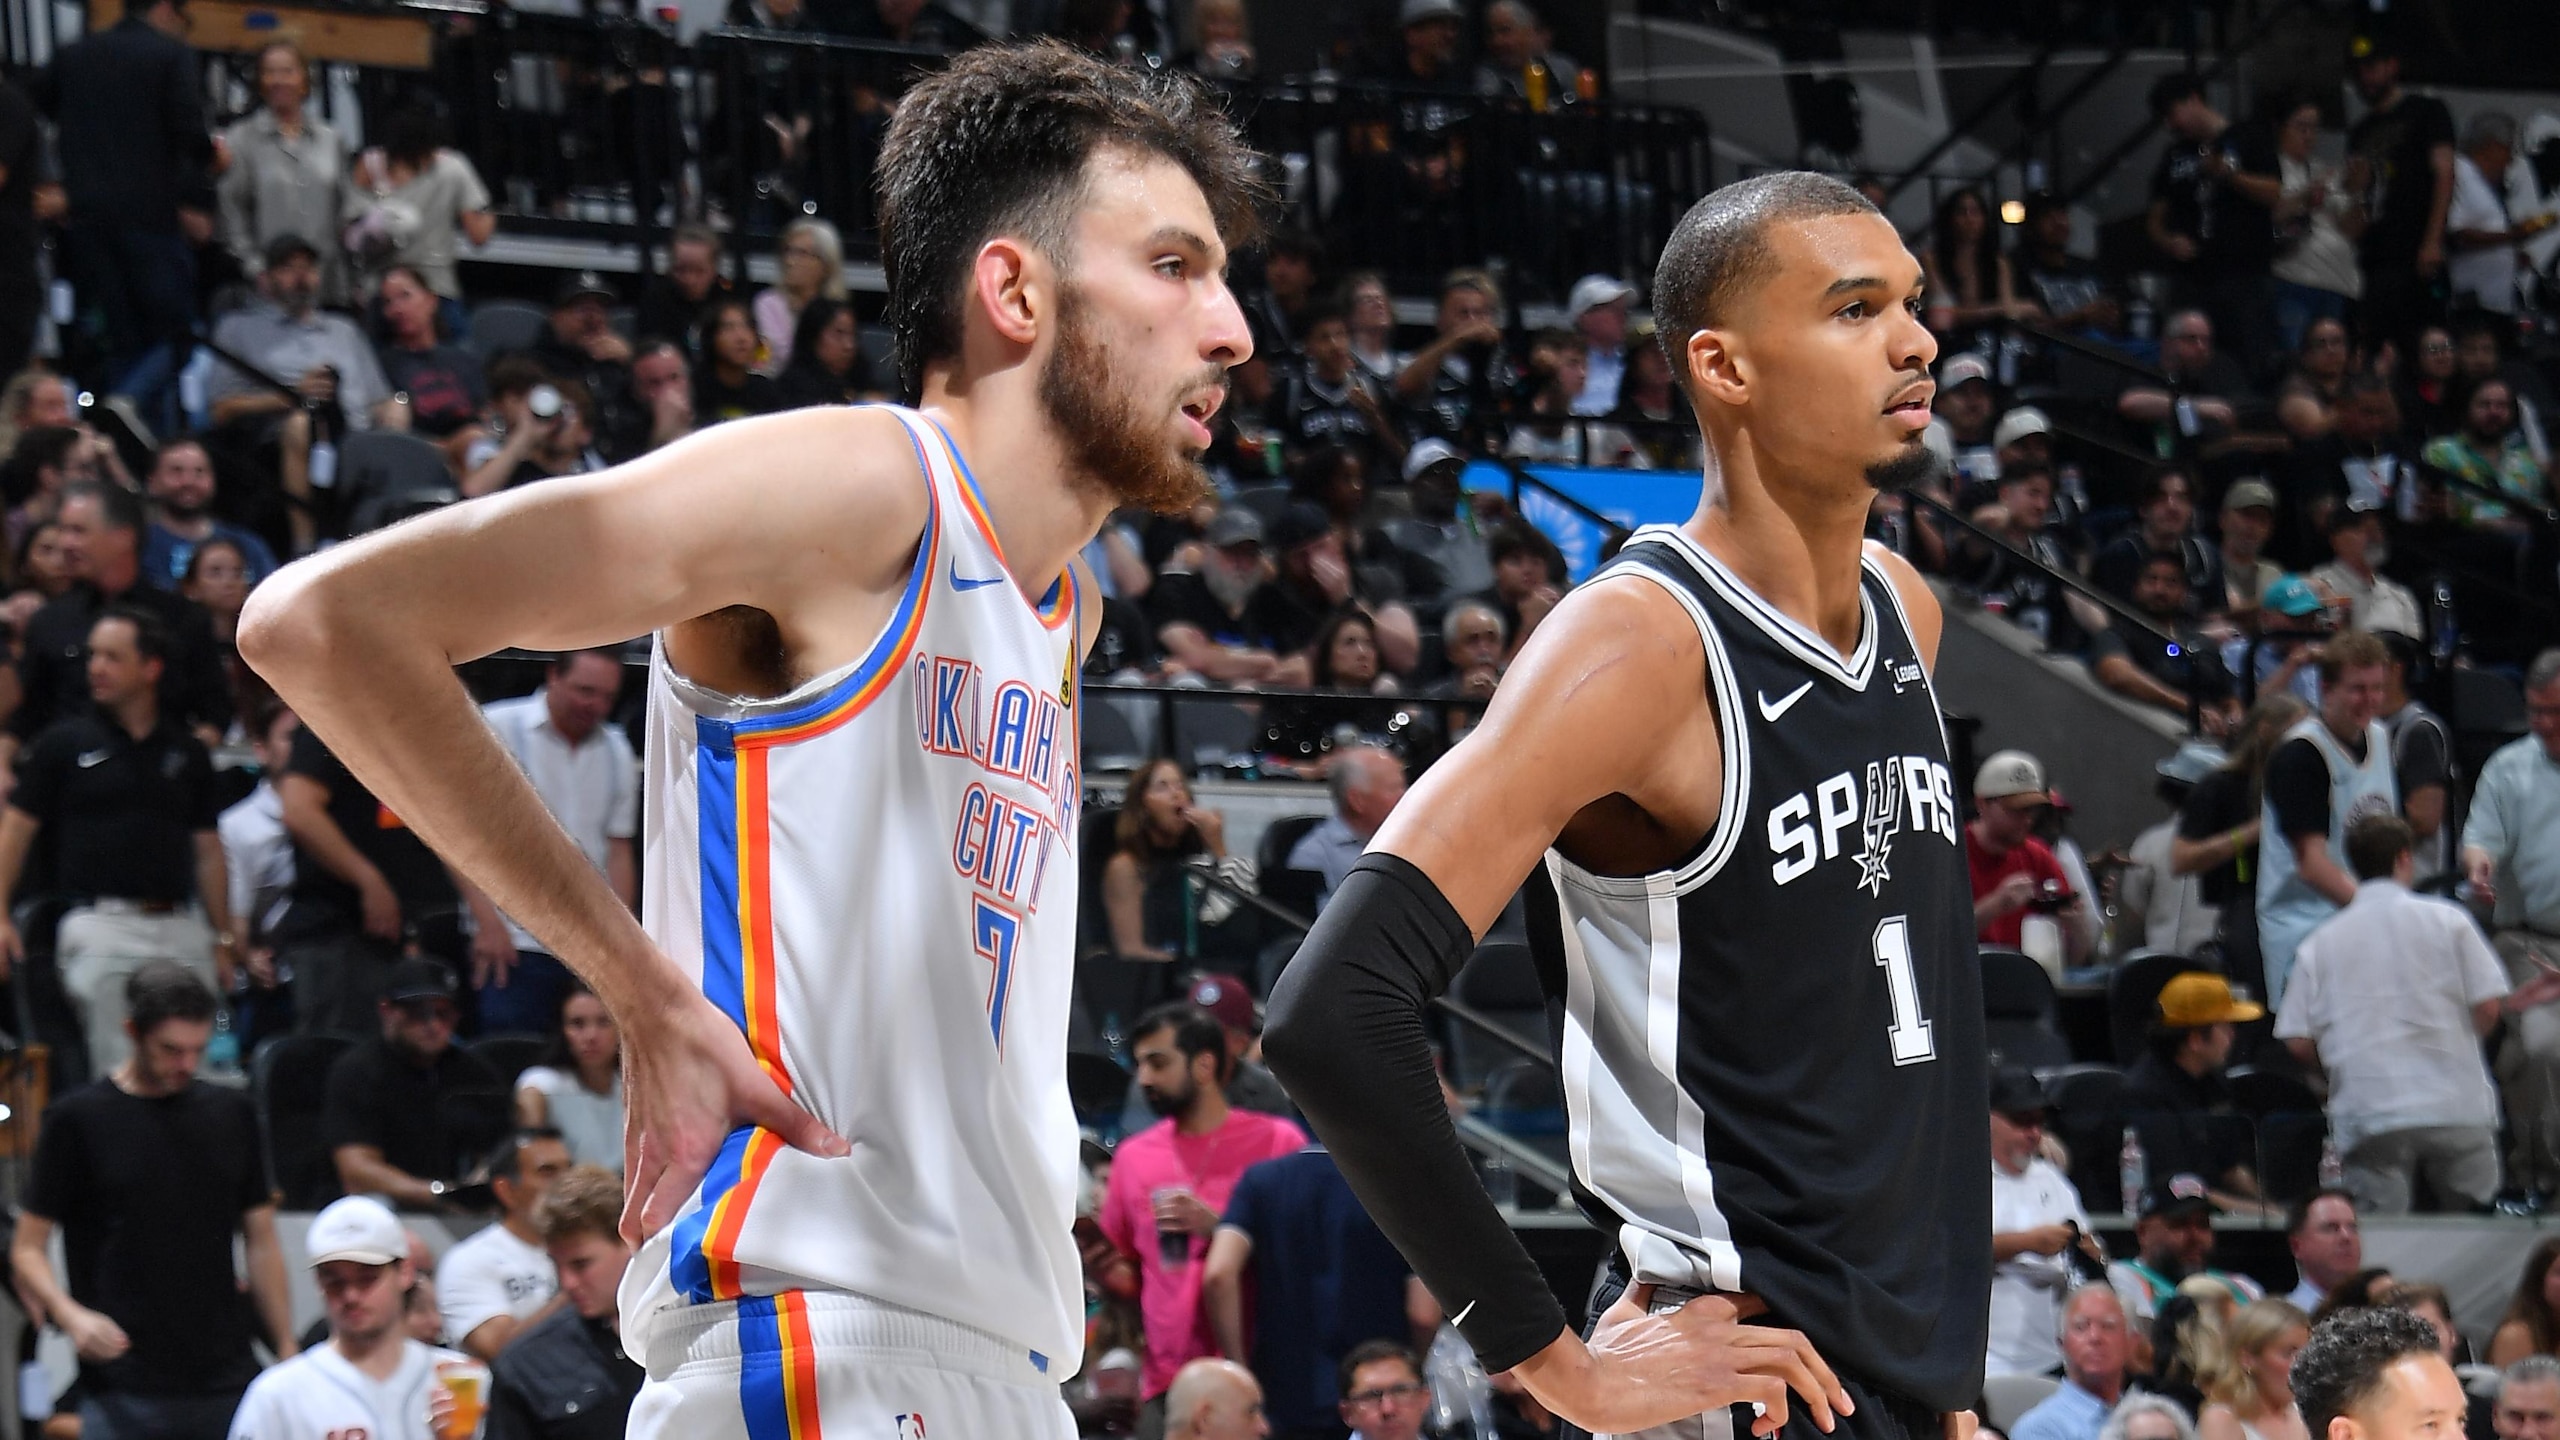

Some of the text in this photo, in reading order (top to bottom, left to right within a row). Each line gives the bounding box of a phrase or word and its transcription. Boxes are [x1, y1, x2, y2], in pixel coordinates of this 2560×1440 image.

[952, 782, 1057, 915] CITY
[1767, 755, 1957, 899] SPURS
[972, 891, 1023, 1064] 7
[1872, 914, 1937, 1067] 1
